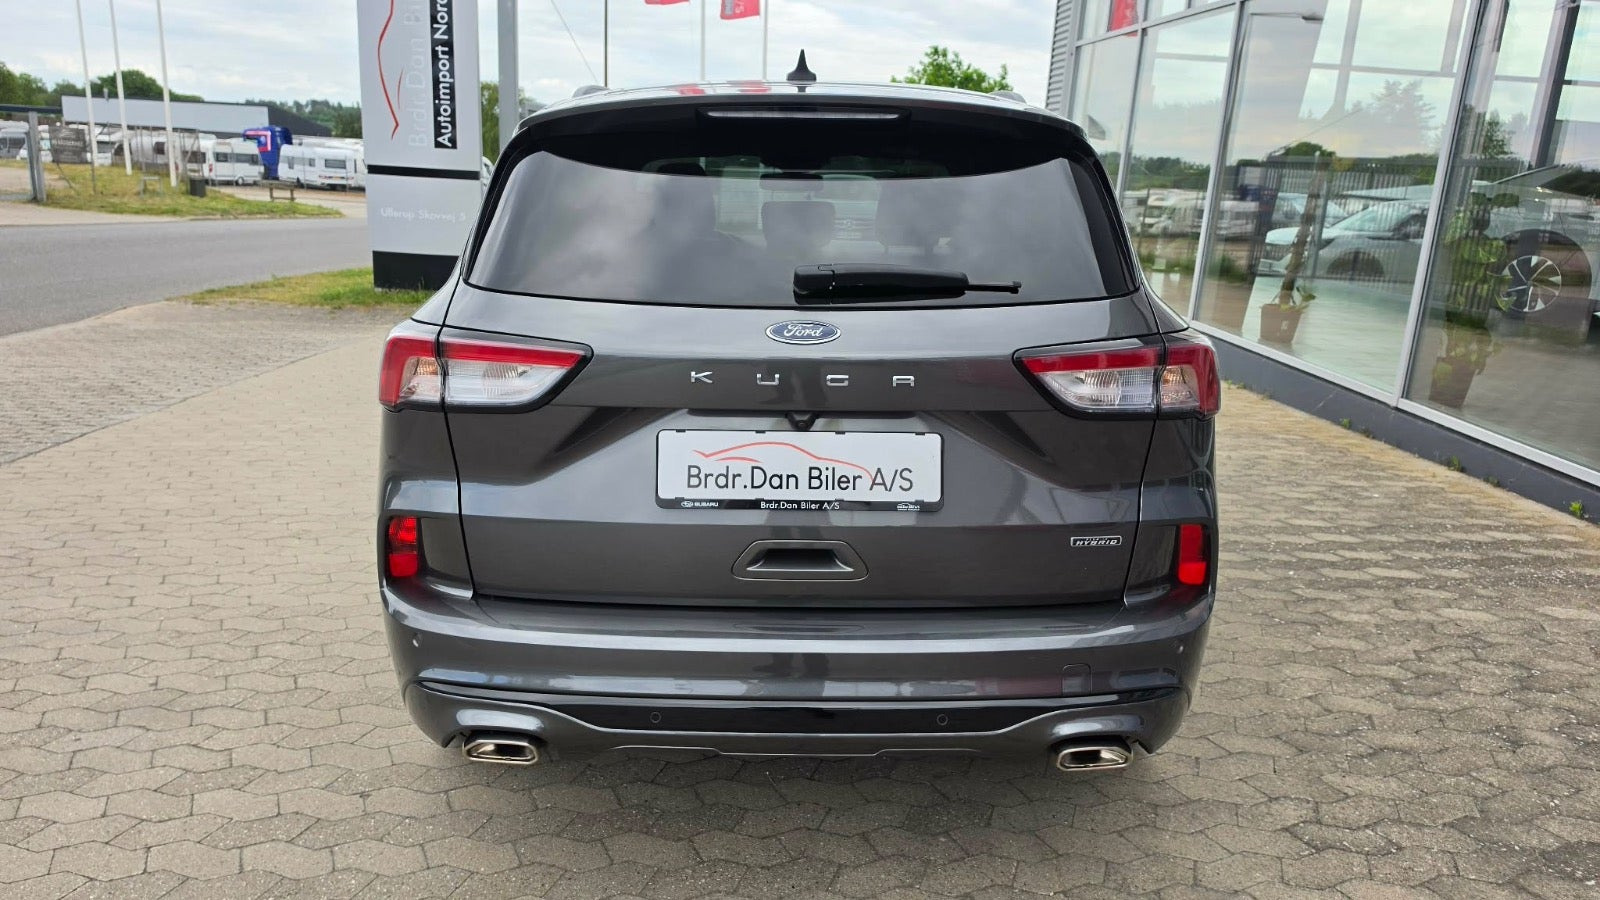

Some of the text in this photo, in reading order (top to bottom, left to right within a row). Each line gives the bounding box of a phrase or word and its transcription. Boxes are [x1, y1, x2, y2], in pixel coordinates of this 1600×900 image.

[435, 45, 453, 148] Autoimport
[784, 324, 823, 336] Ford
[690, 371, 915, 387] KUGA
[687, 465, 913, 492] Brdr.Dan Biler A/S
[760, 501, 840, 510] Brdr.Dan Biler A/S
